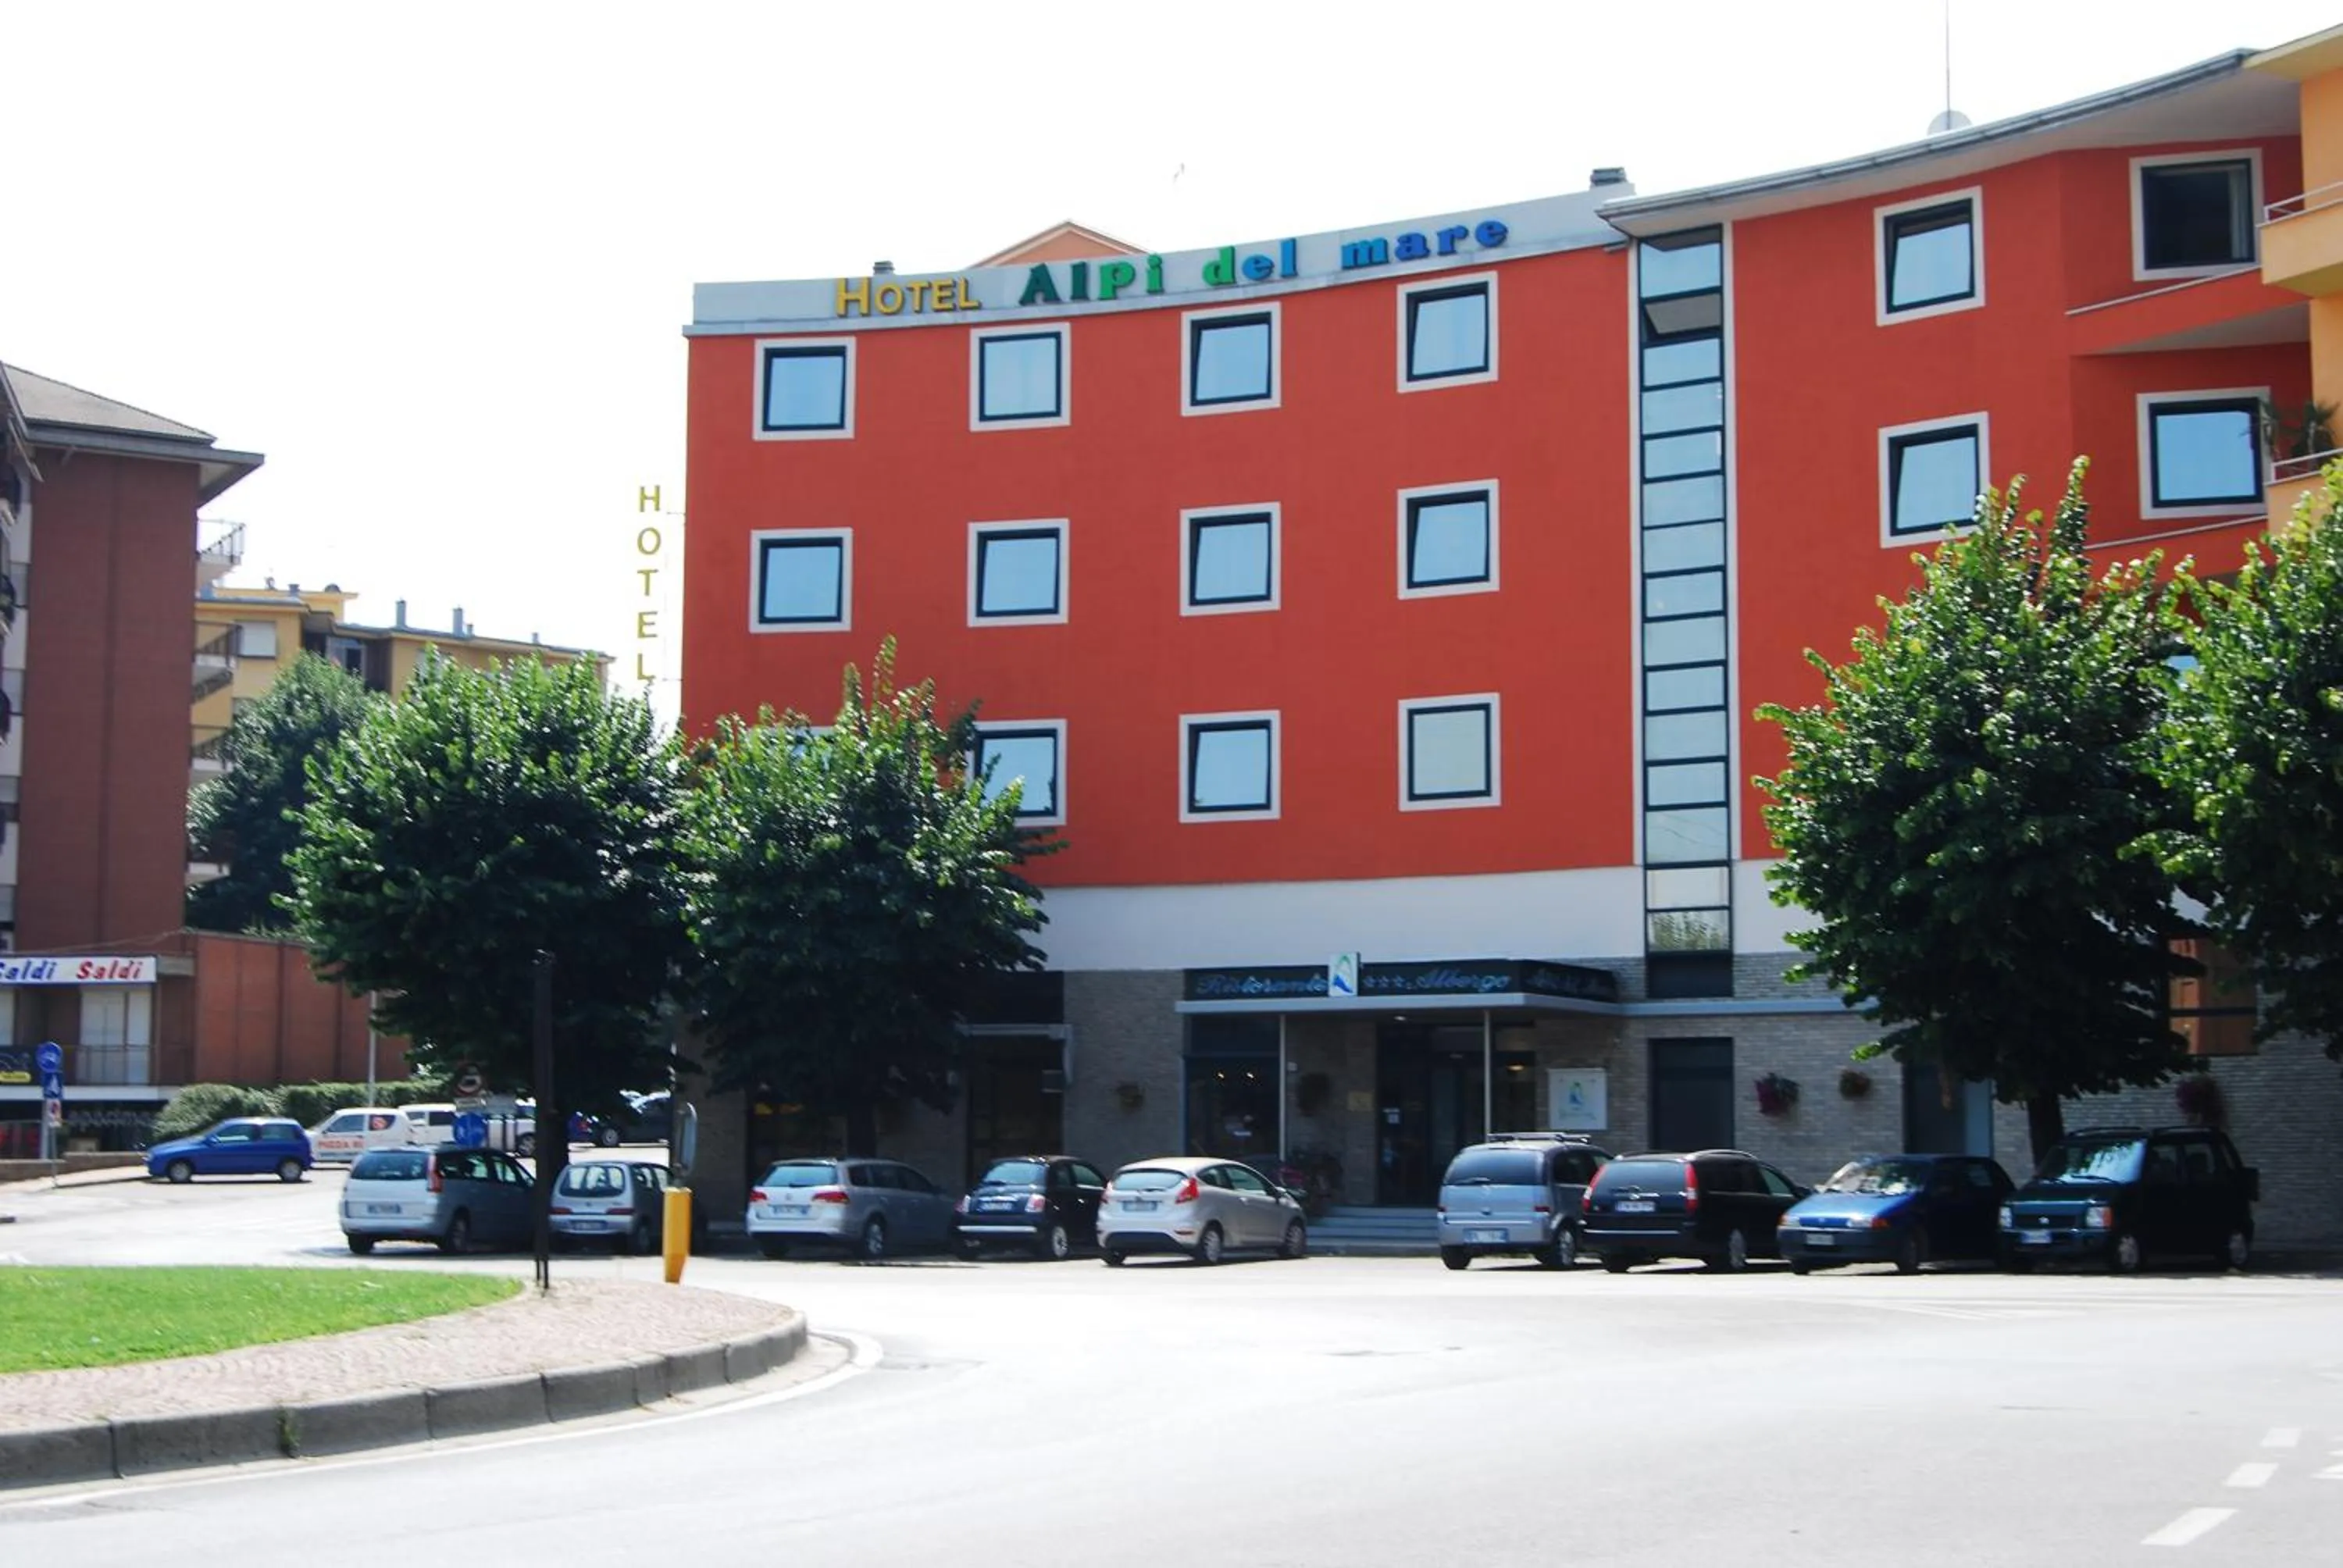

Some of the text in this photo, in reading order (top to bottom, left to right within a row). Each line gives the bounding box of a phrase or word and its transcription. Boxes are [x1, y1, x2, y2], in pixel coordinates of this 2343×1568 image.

[835, 219, 1509, 317] HOTEL Alpi del mare
[637, 484, 662, 681] HOTEL
[76, 960, 144, 980] Saldi
